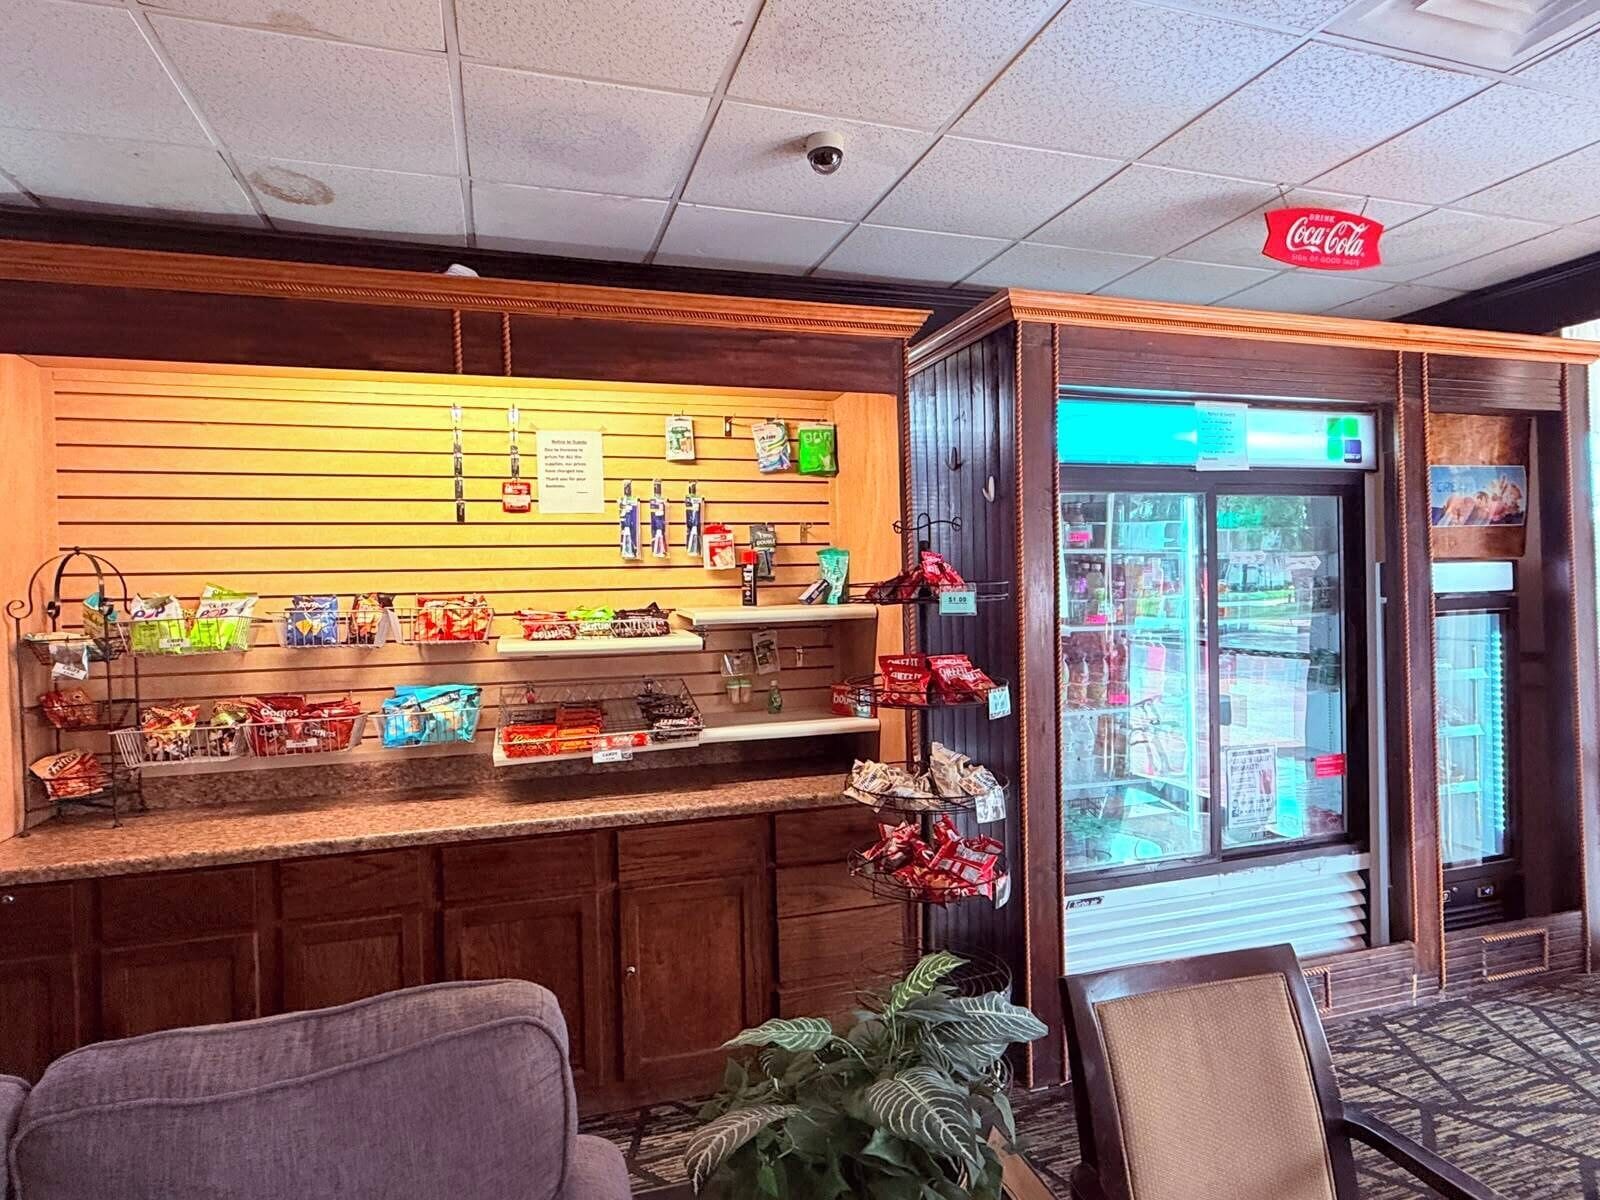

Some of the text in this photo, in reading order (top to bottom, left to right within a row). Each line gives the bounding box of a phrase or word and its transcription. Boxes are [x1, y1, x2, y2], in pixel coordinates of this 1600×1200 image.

[1309, 214, 1335, 223] DRINK
[1286, 217, 1369, 257] Coca-Cola
[1320, 256, 1341, 264] GOOD
